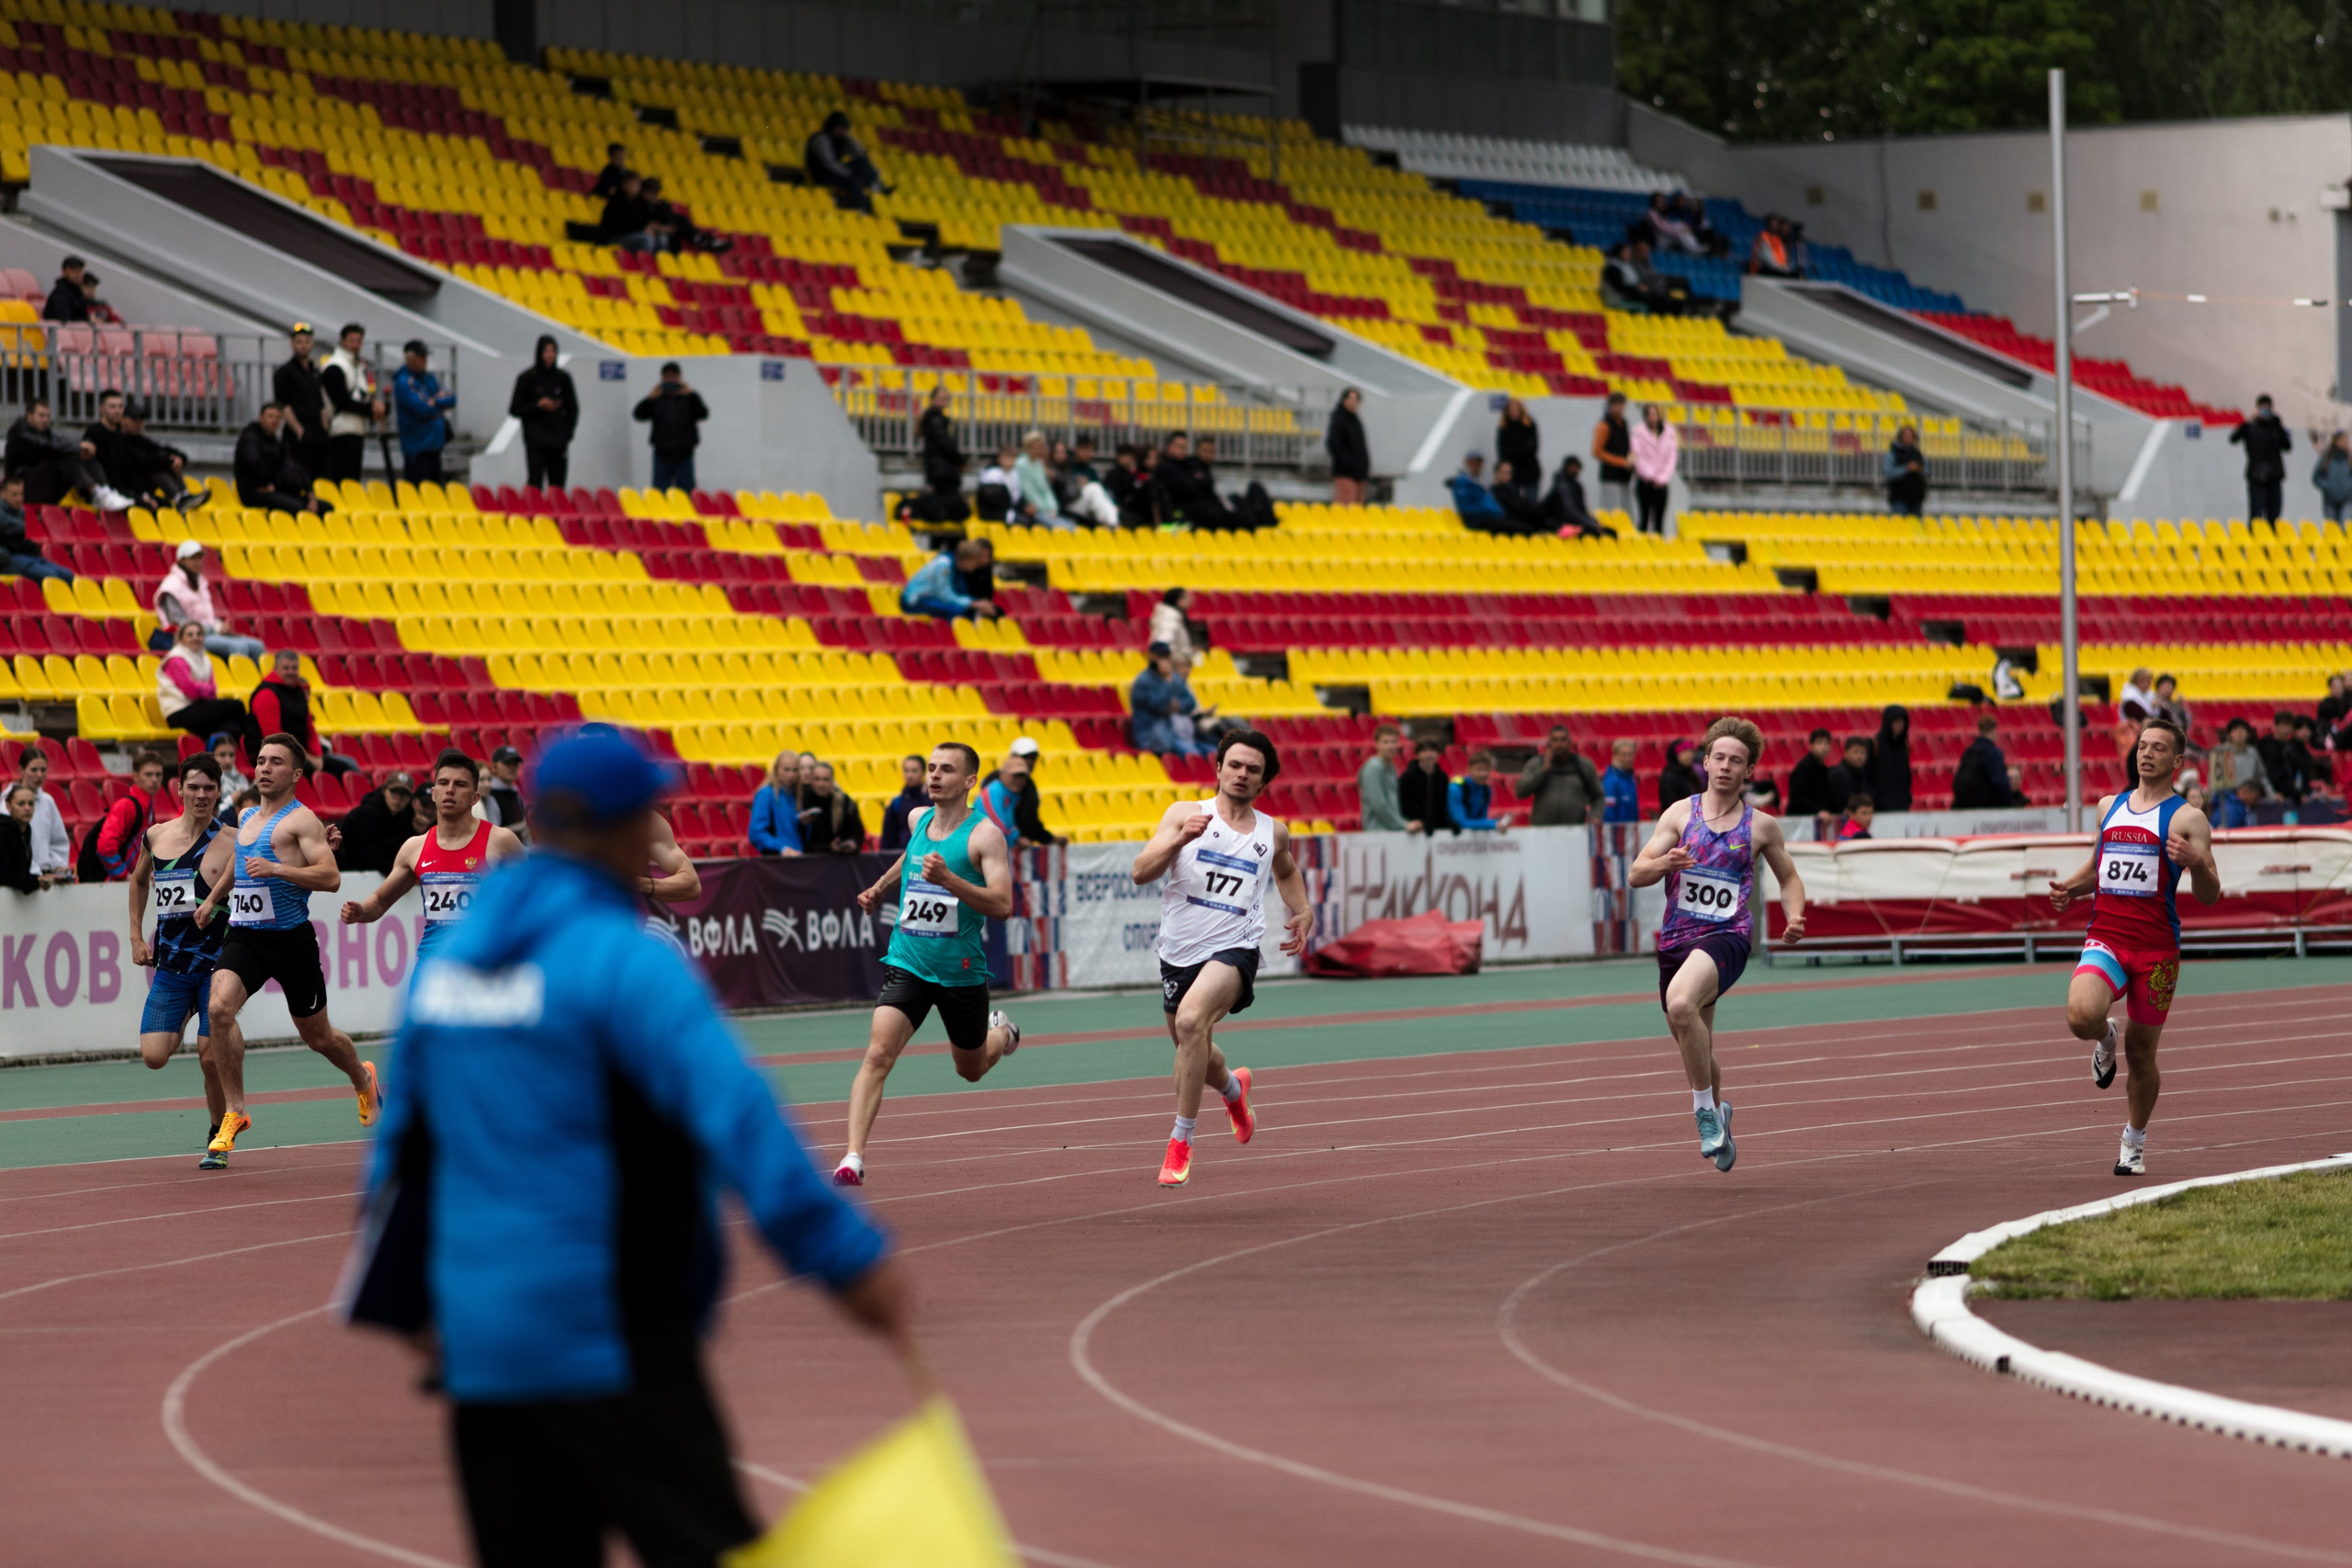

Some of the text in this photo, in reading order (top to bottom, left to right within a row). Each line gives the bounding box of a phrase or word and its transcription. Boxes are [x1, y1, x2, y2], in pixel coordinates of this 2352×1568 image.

[2111, 830, 2148, 843] RUSSIA
[2107, 860, 2148, 883] 874
[1205, 871, 1244, 897] 177
[1684, 881, 1733, 909] 300
[156, 886, 187, 907] 292
[233, 893, 264, 914] 740
[429, 890, 474, 912] 240
[907, 899, 948, 923] 249
[689, 912, 758, 958] ВФЛА
[807, 908, 876, 951] ВФЛА
[2, 930, 122, 1010] КОВ
